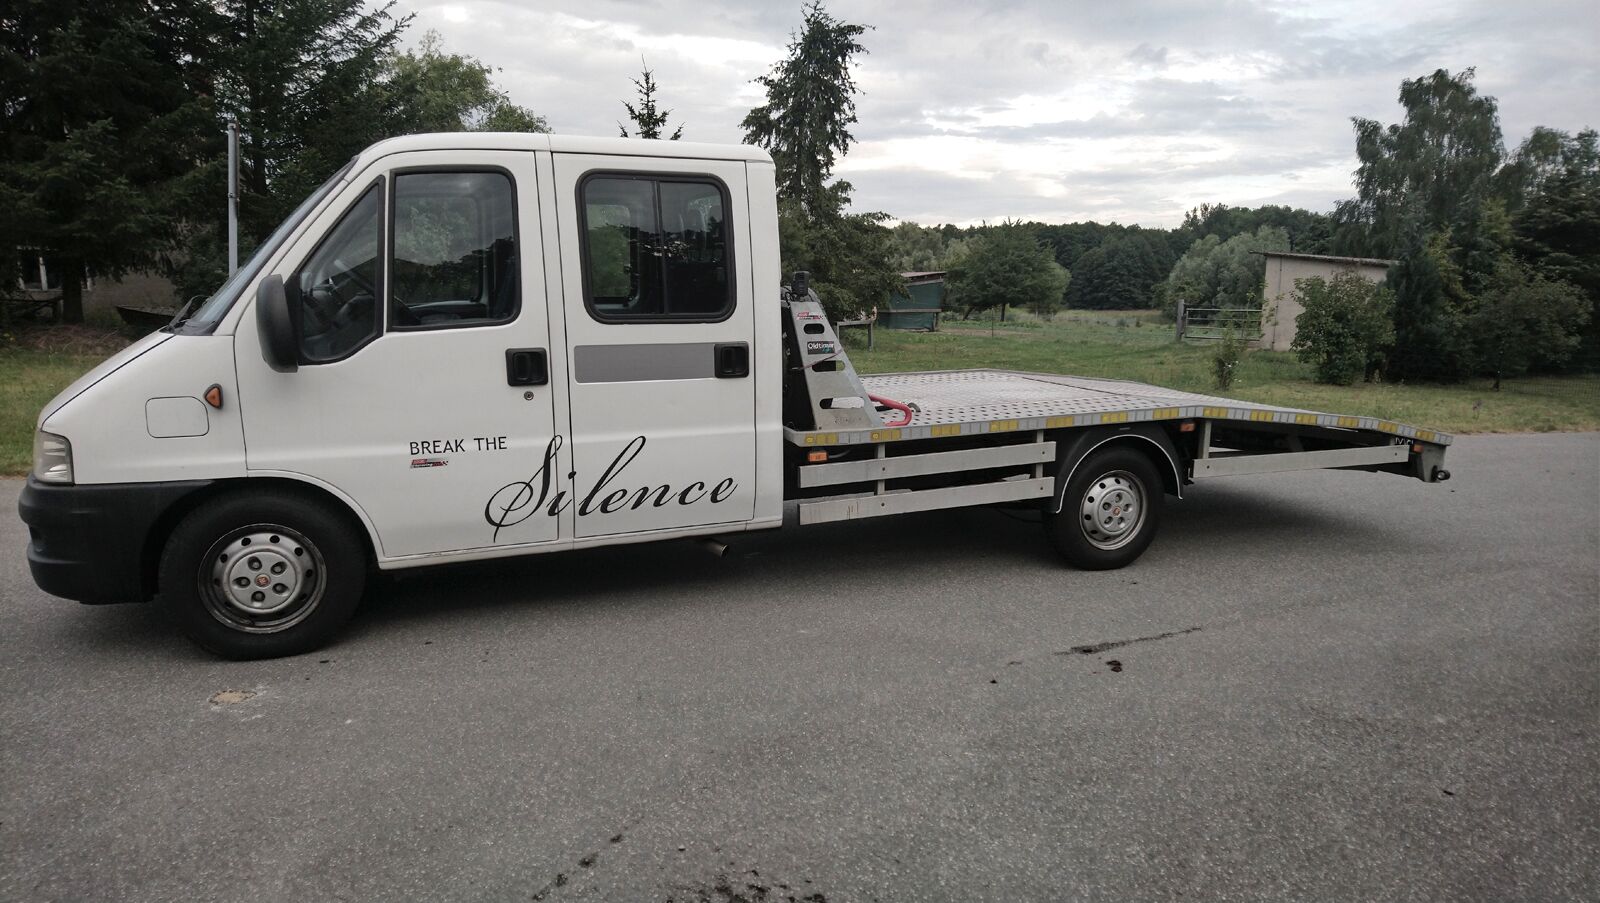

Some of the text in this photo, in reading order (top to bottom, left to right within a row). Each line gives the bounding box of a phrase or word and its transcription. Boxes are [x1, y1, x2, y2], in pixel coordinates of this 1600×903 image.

[409, 436, 507, 455] BREAK THE
[484, 434, 738, 543] Silence
